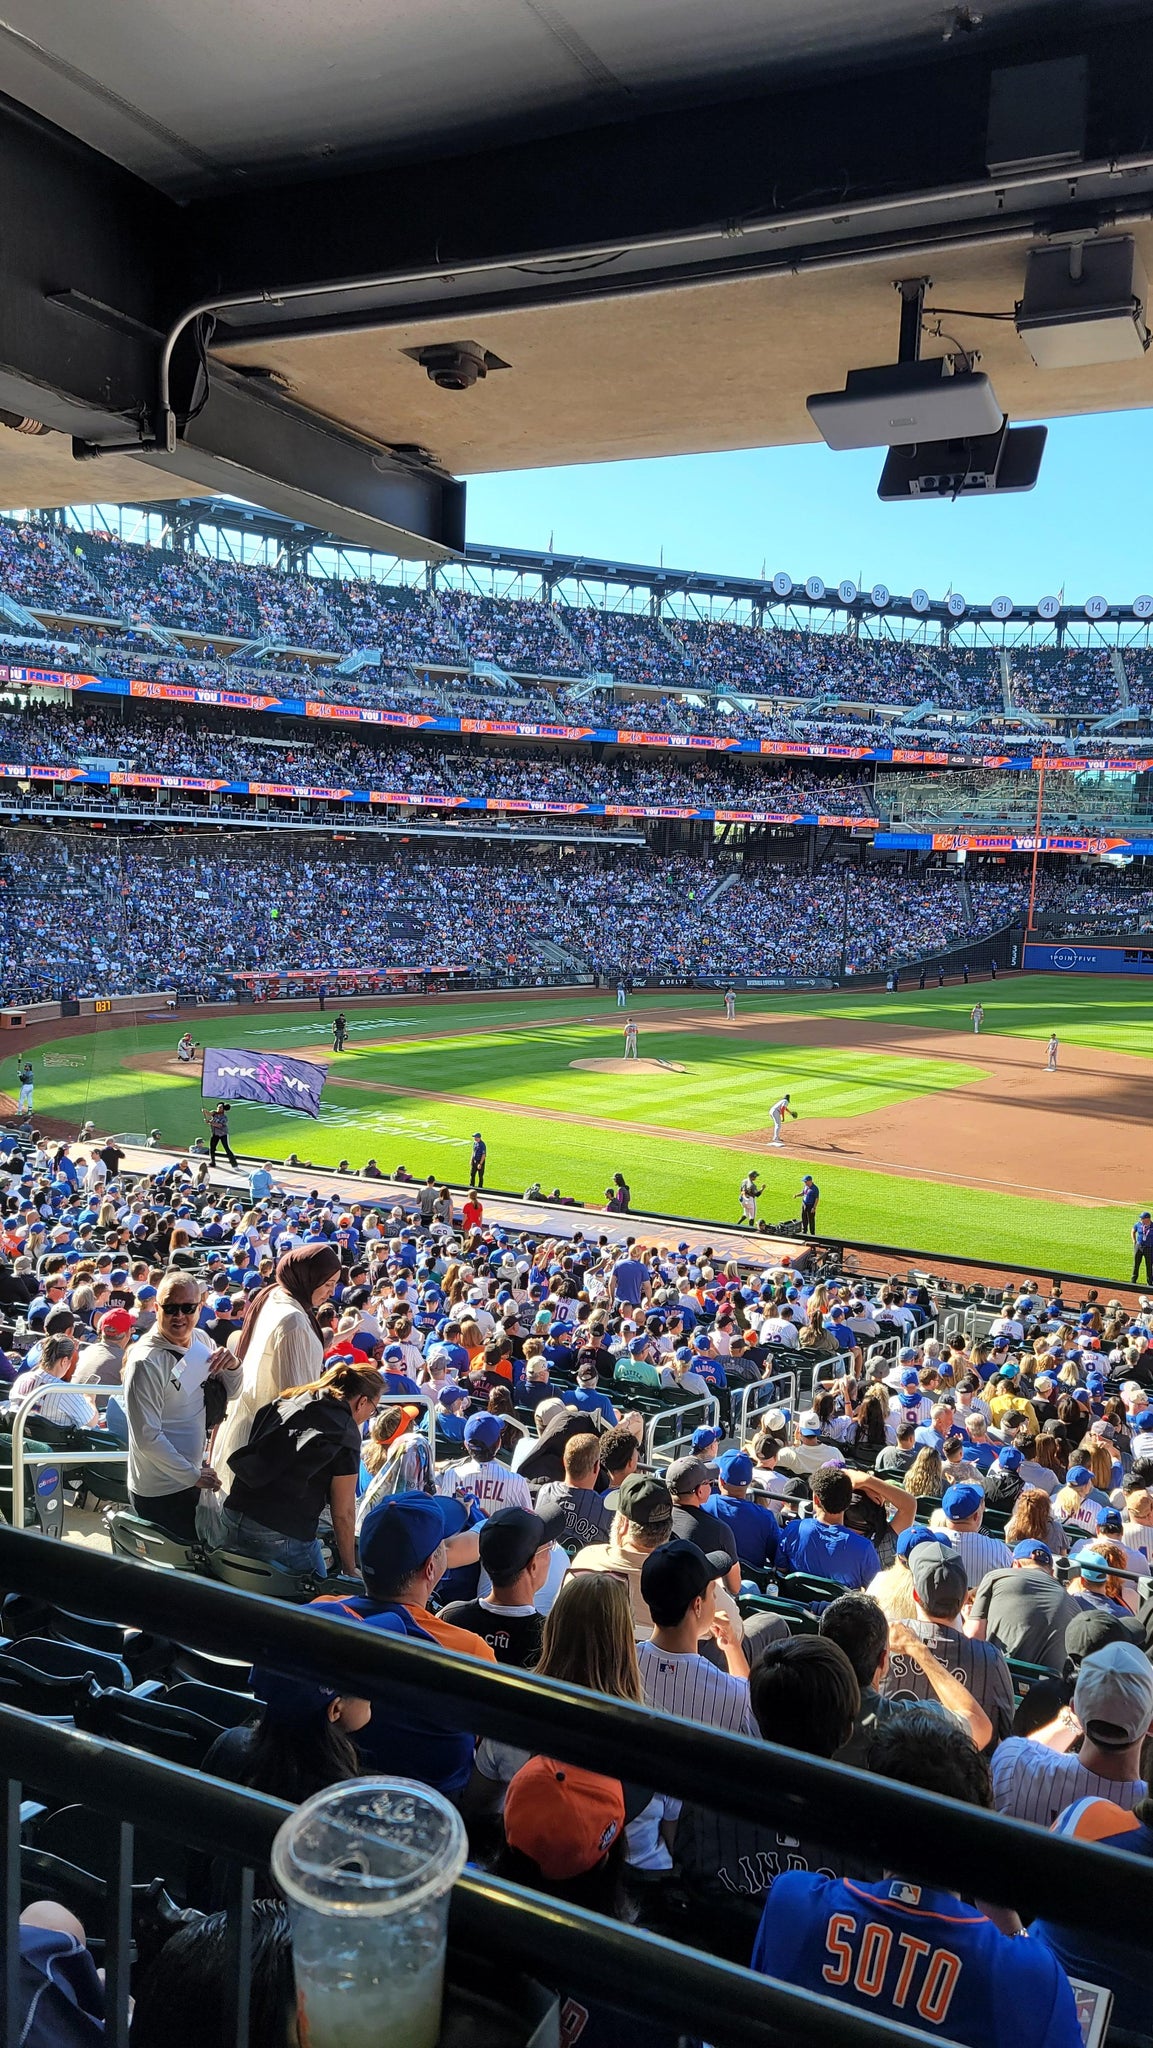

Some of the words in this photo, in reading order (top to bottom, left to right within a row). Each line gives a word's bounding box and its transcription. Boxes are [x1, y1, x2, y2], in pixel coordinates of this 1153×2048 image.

[779, 579, 785, 589] 5
[811, 583, 819, 593] 18
[843, 587, 852, 597] 16
[875, 590, 886, 601] 24
[916, 595, 925, 606] 17
[951, 601, 962, 610] 36
[997, 602, 1007, 612] 31
[1043, 602, 1054, 612] 41
[1091, 602, 1101, 612] 14
[1138, 602, 1150, 612] 37
[198, 692, 218, 702] YOU
[362, 712, 378, 720] YOU
[520, 725, 537, 734] YOU
[671, 737, 687, 745] YOU
[810, 746, 825, 754] YOU
[7, 767, 26, 775] YOU
[975, 838, 1011, 847] THANK
[1016, 838, 1042, 849] YOU
[1049, 839, 1087, 849] FANS!
[95, 1000, 111, 1012] 037
[485, 1633, 510, 1649] citi
[822, 1912, 964, 2025] SOTO
